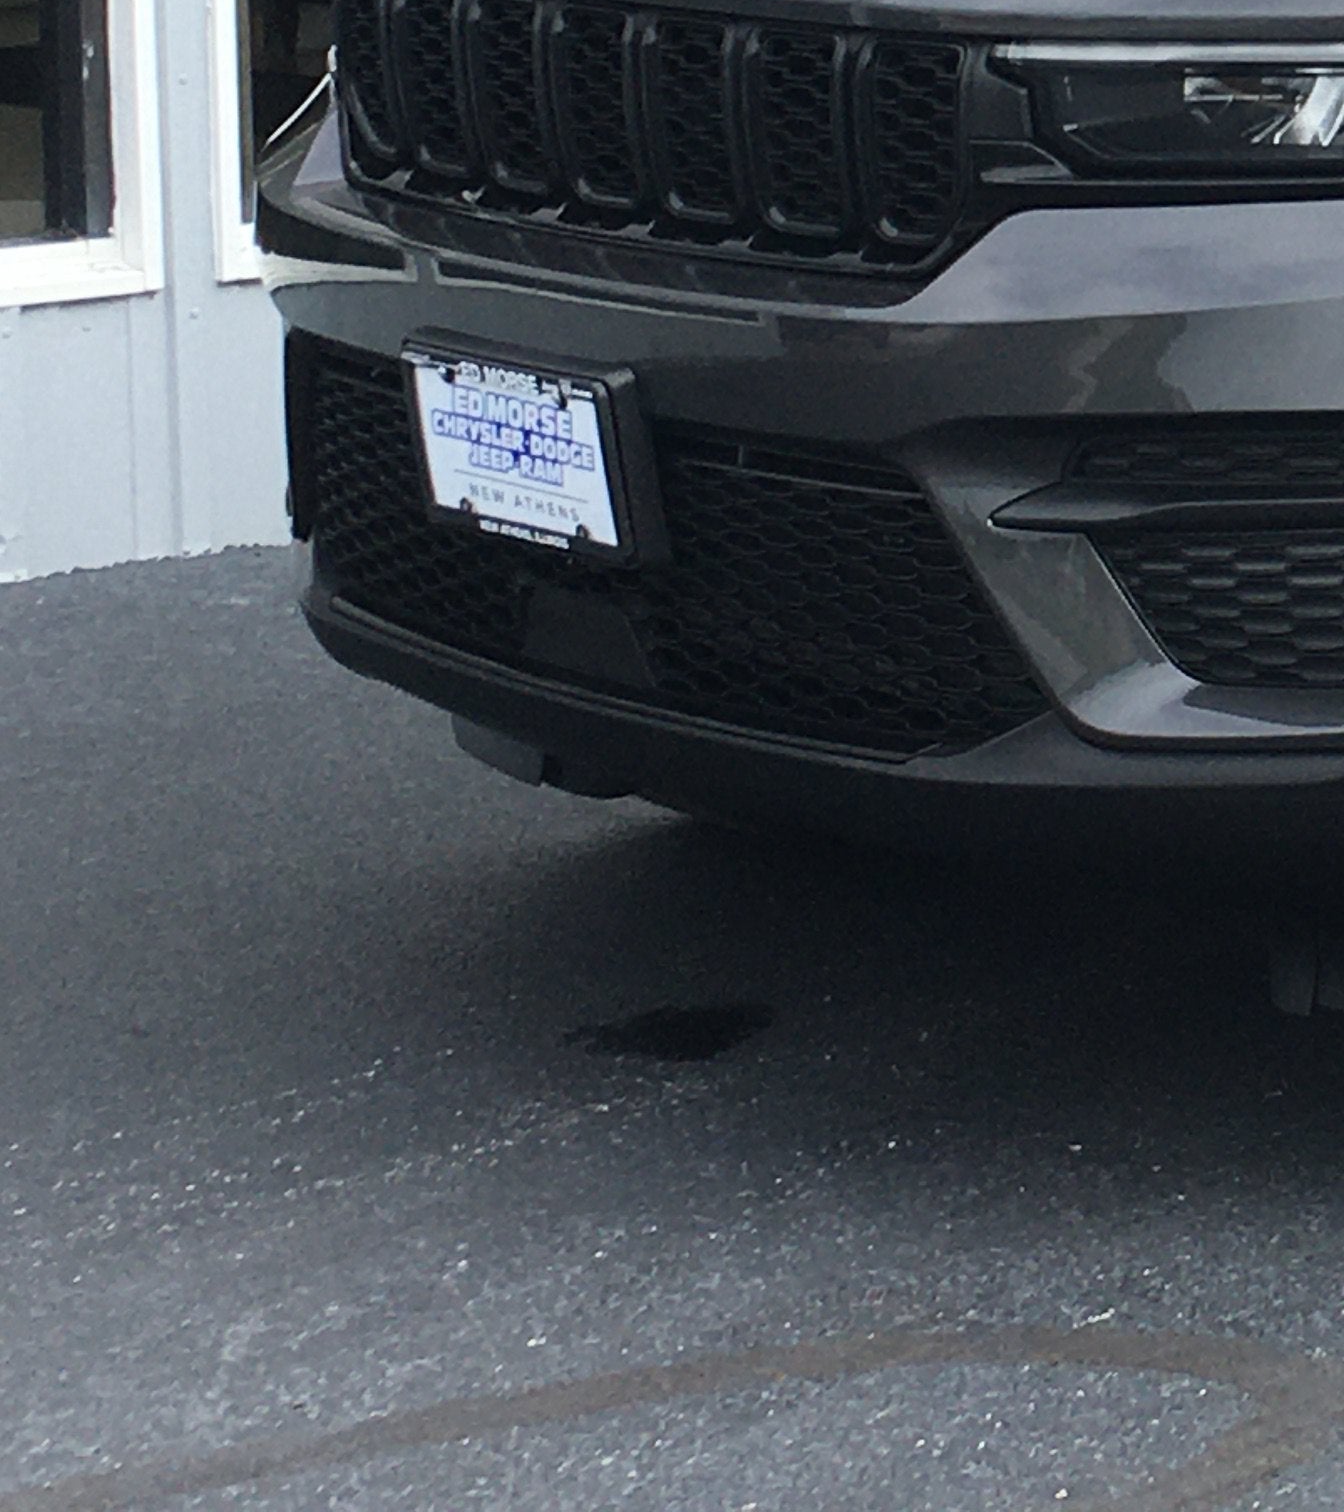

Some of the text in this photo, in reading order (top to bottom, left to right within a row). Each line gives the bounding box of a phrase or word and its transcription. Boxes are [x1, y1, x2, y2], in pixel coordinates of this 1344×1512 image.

[453, 387, 572, 440] ED MORSE
[432, 410, 595, 471] CHRYSLER DODGE
[469, 442, 564, 487] JEEP RAM
[469, 482, 581, 523] NEW ATHENS
